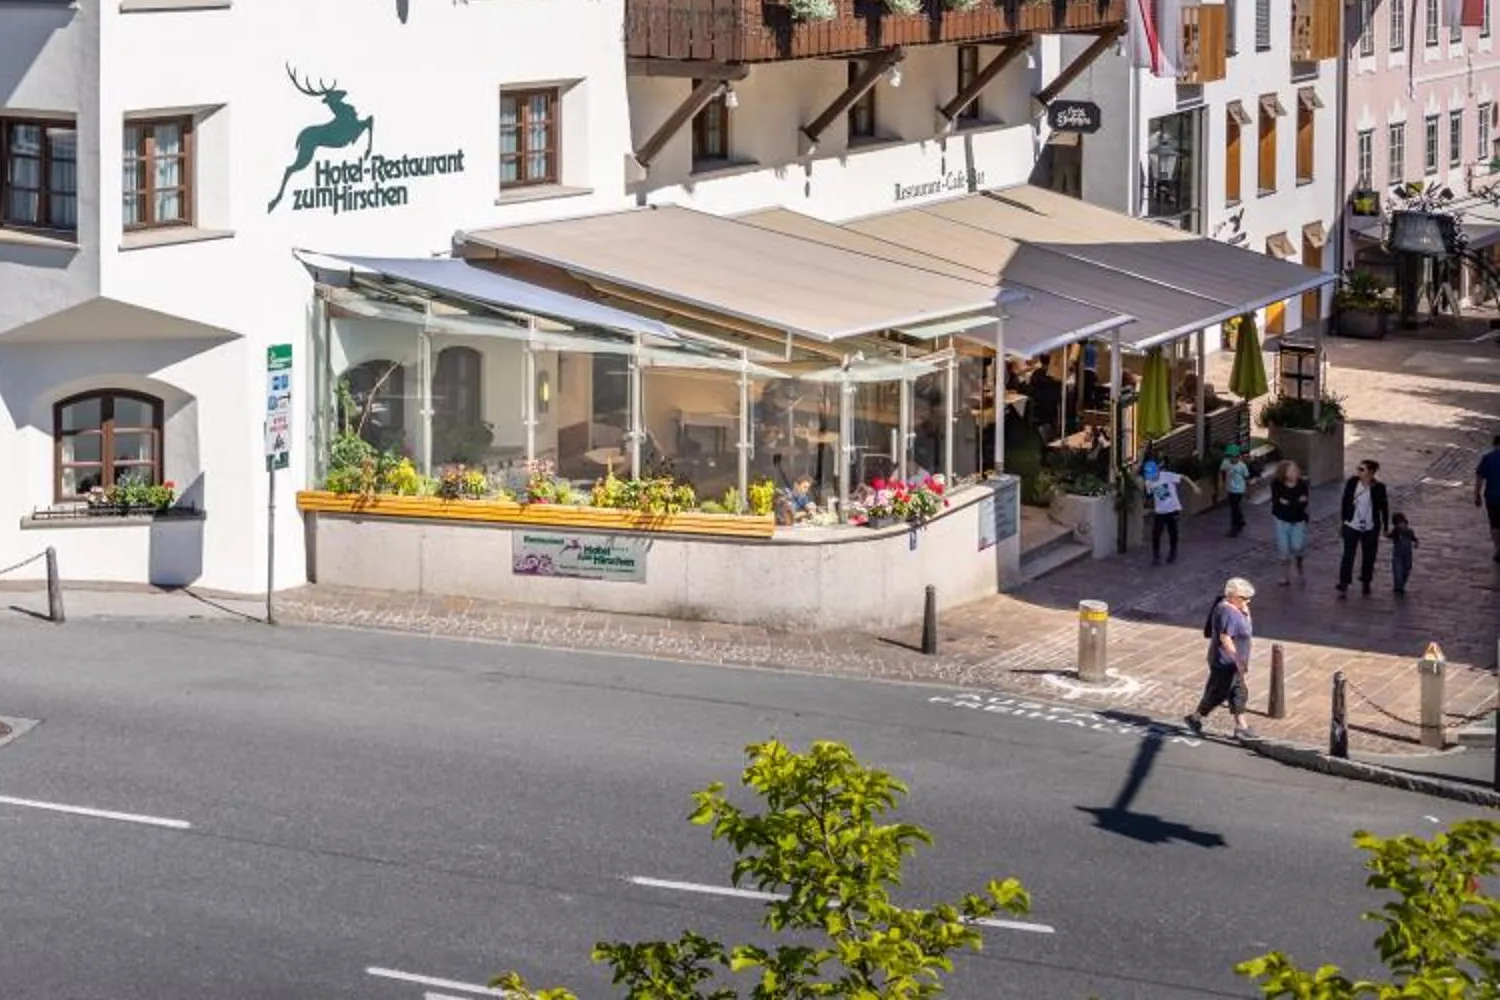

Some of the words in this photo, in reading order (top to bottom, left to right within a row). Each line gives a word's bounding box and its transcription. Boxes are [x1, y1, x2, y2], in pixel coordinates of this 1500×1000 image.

[315, 149, 465, 186] Hotel-Restaurant
[293, 187, 332, 211] zum
[332, 182, 408, 216] Hirschen
